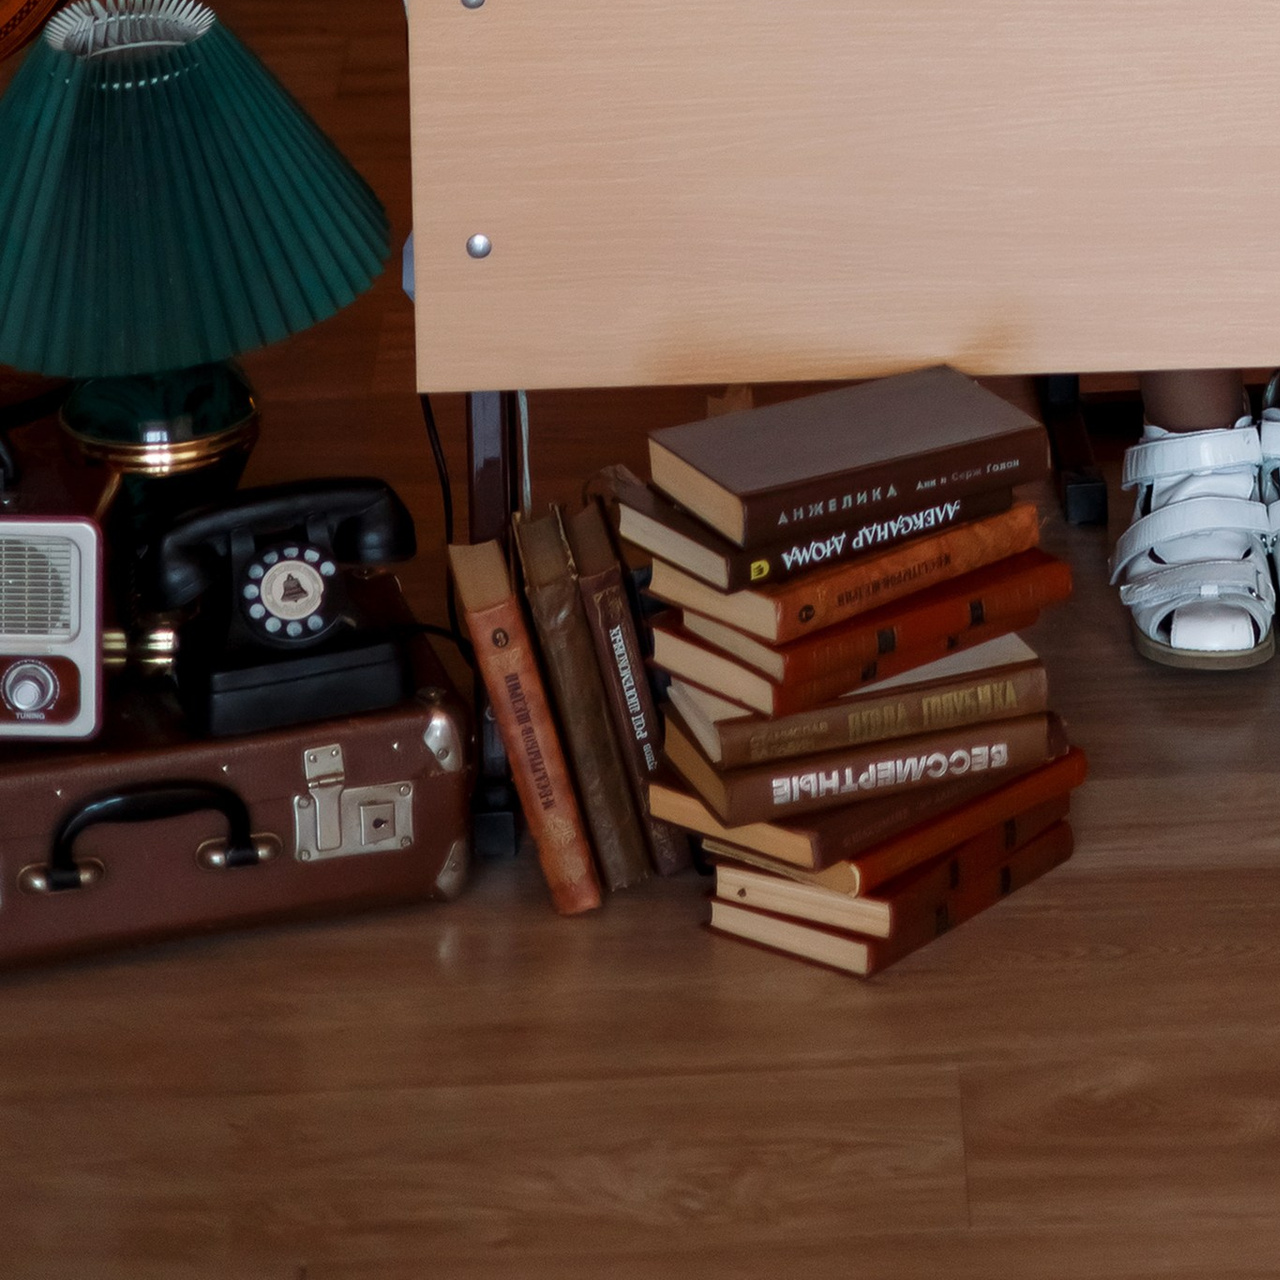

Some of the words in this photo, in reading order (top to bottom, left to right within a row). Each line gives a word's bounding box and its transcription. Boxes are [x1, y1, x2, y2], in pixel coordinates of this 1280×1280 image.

[777, 484, 898, 526] АНЖЕЛИКА
[852, 499, 961, 552] АЛЕКСАНДР
[780, 532, 847, 571] ДЮМА
[15, 712, 46, 720] TUNING
[771, 743, 1009, 805] БЕССМЕРТНЫЕ
